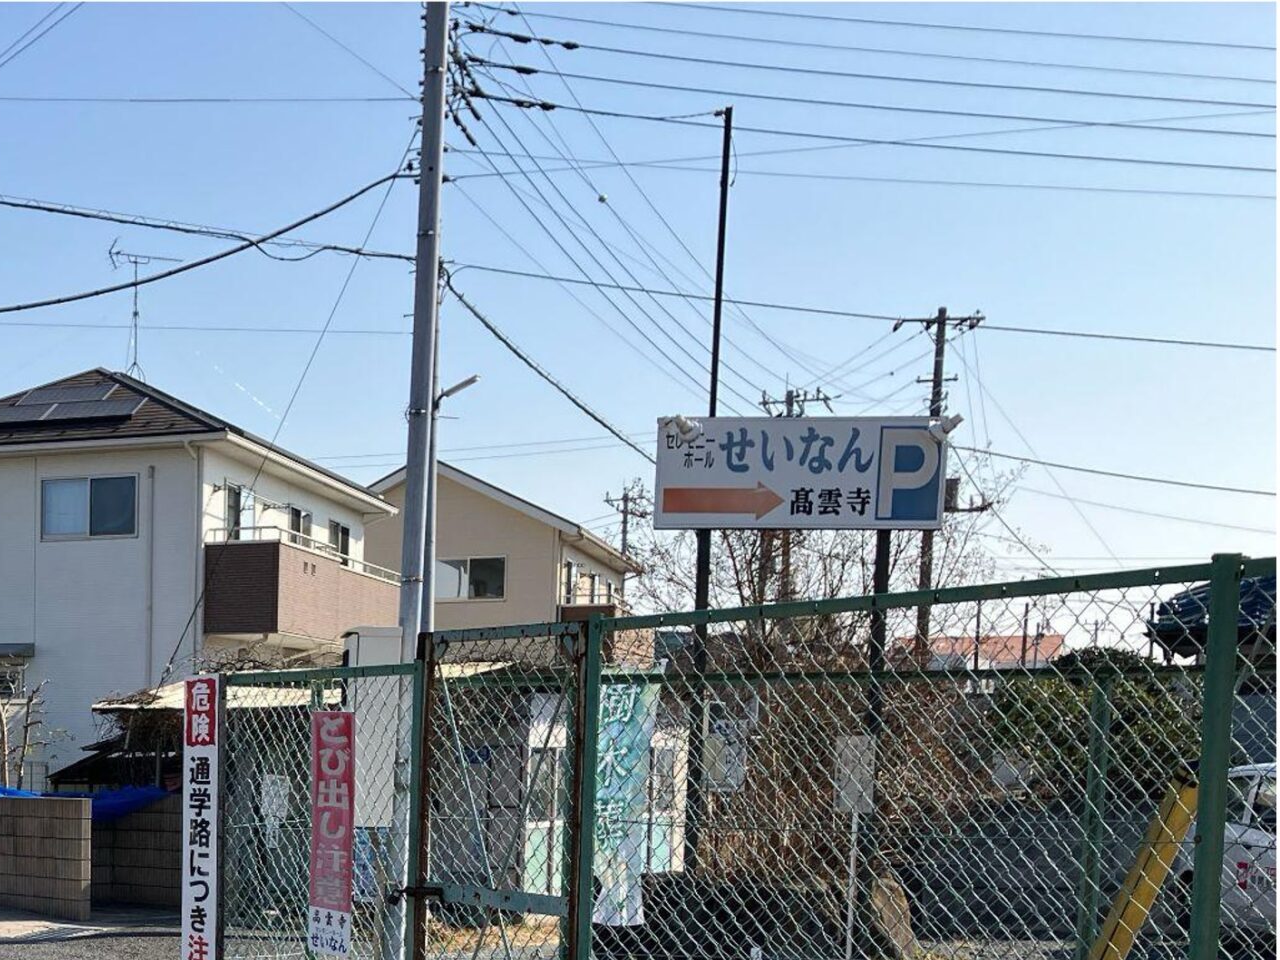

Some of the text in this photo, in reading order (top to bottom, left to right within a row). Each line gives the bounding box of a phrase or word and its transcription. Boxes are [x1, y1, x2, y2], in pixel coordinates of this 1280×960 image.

[684, 450, 714, 469] ホール
[720, 426, 874, 474] せいなん
[878, 428, 939, 518] P
[191, 681, 210, 743] 危険
[314, 715, 350, 904] とび出し注意
